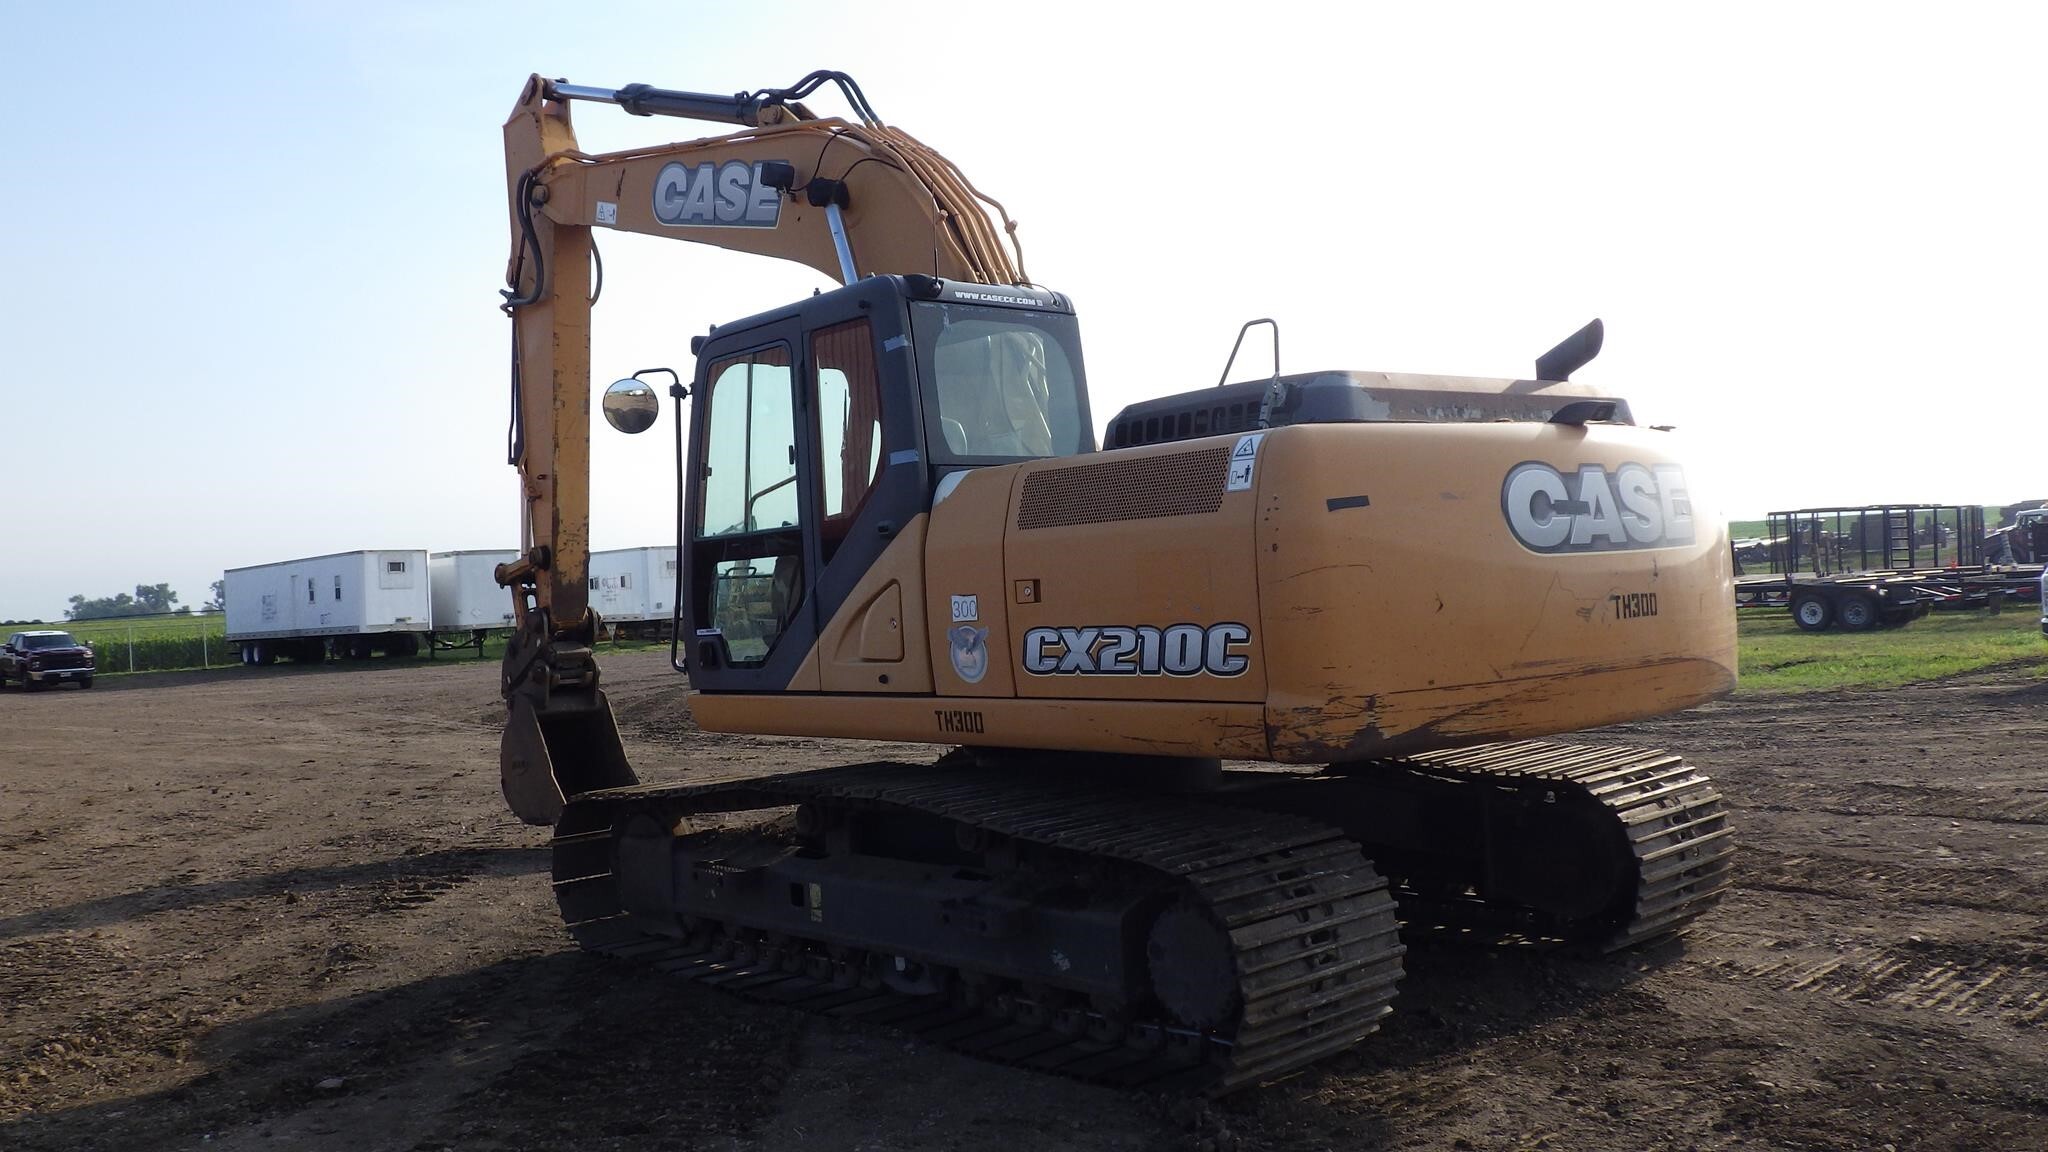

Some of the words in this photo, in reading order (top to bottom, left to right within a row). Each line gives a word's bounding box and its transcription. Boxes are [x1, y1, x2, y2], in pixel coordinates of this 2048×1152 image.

[653, 160, 784, 224] CASE
[954, 290, 1036, 307] WWW.CASECE.COM
[1502, 461, 1697, 551] CASE
[952, 600, 977, 618] 300
[1614, 592, 1658, 620] TH300
[1023, 622, 1251, 678] CX210C
[934, 709, 985, 734] TH300
